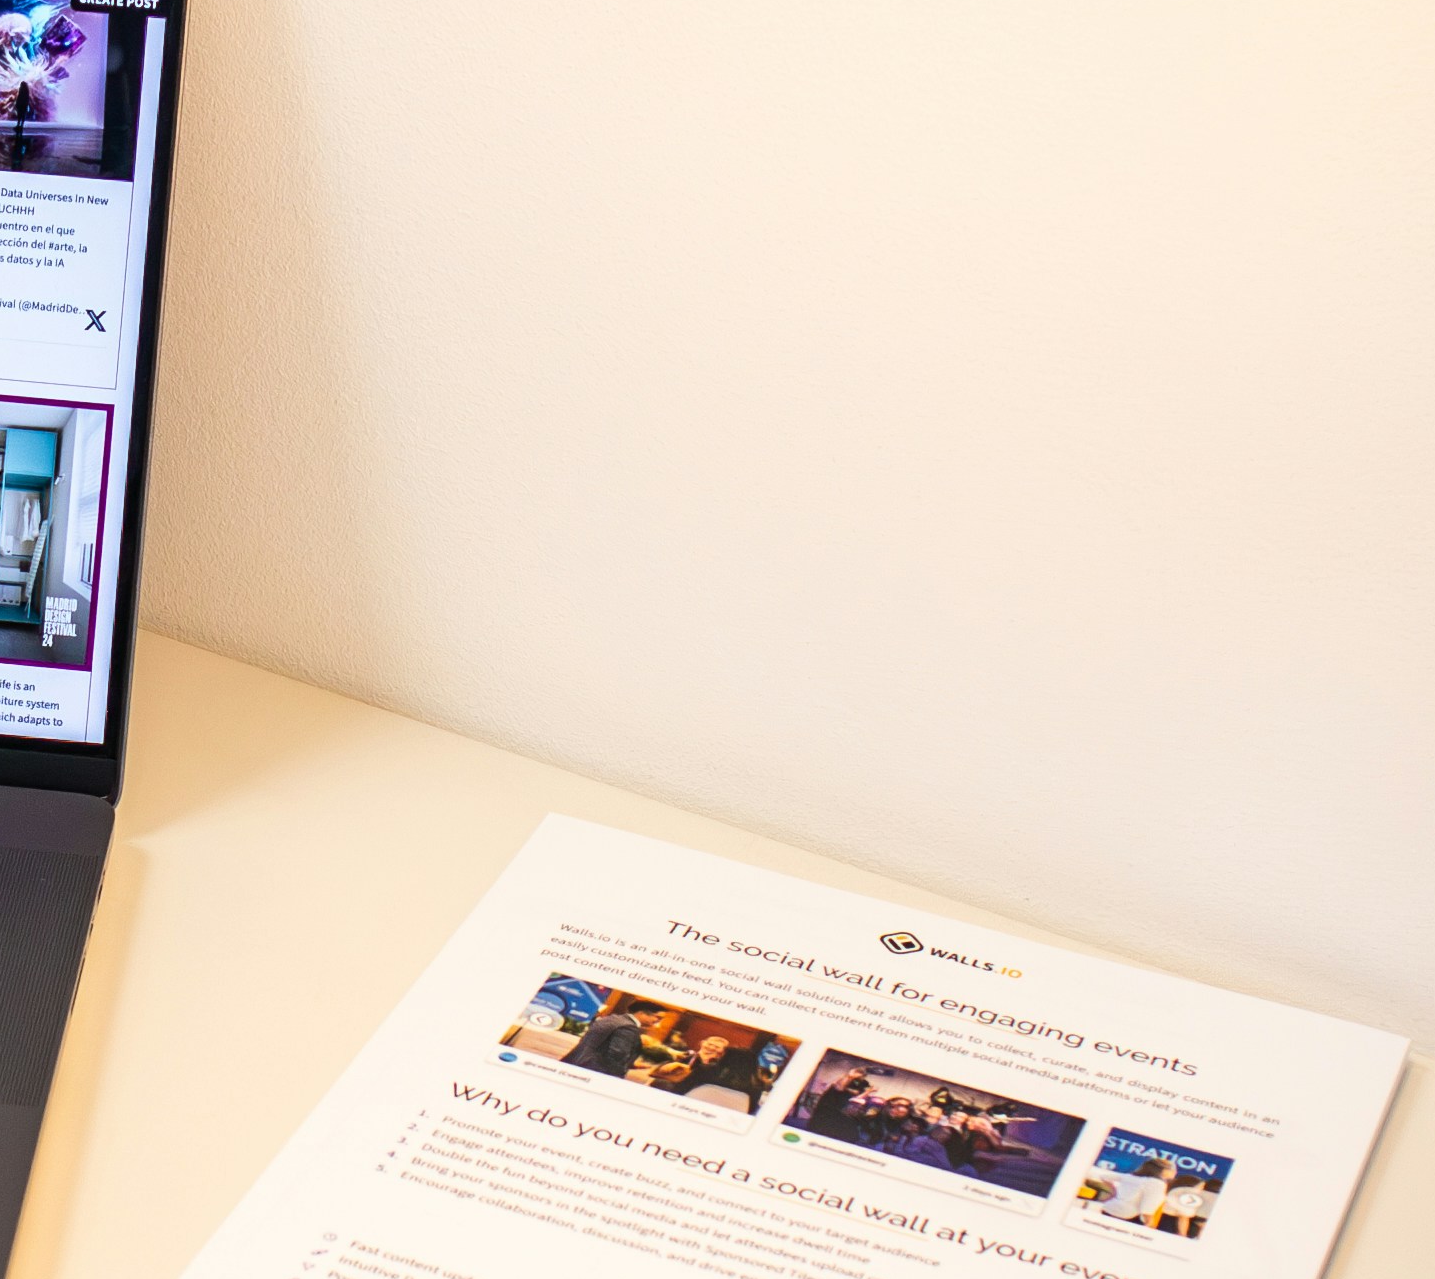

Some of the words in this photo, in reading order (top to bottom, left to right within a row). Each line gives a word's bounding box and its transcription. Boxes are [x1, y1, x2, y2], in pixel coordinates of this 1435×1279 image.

[539, 948, 571, 961] post
[573, 957, 626, 976] content
[627, 971, 679, 992] directly
[680, 987, 699, 997] on
[701, 992, 734, 1005] your
[736, 1002, 765, 1015] wall.
[667, 919, 720, 945] The
[726, 941, 815, 972] social
[822, 965, 883, 991] wall
[890, 981, 933, 1002] for
[939, 999, 1085, 1049] engaging
[1093, 1041, 1197, 1076] events
[929, 946, 1022, 978] WALLS.IO
[452, 1081, 521, 1116] Why
[526, 1108, 568, 1128] do
[573, 1122, 634, 1148] you
[641, 1142, 726, 1175] need
[731, 1169, 750, 1183] a
[759, 1176, 855, 1212] social
[863, 1204, 929, 1234] wall
[935, 1227, 968, 1245] at
[975, 1237, 1052, 1266] your
